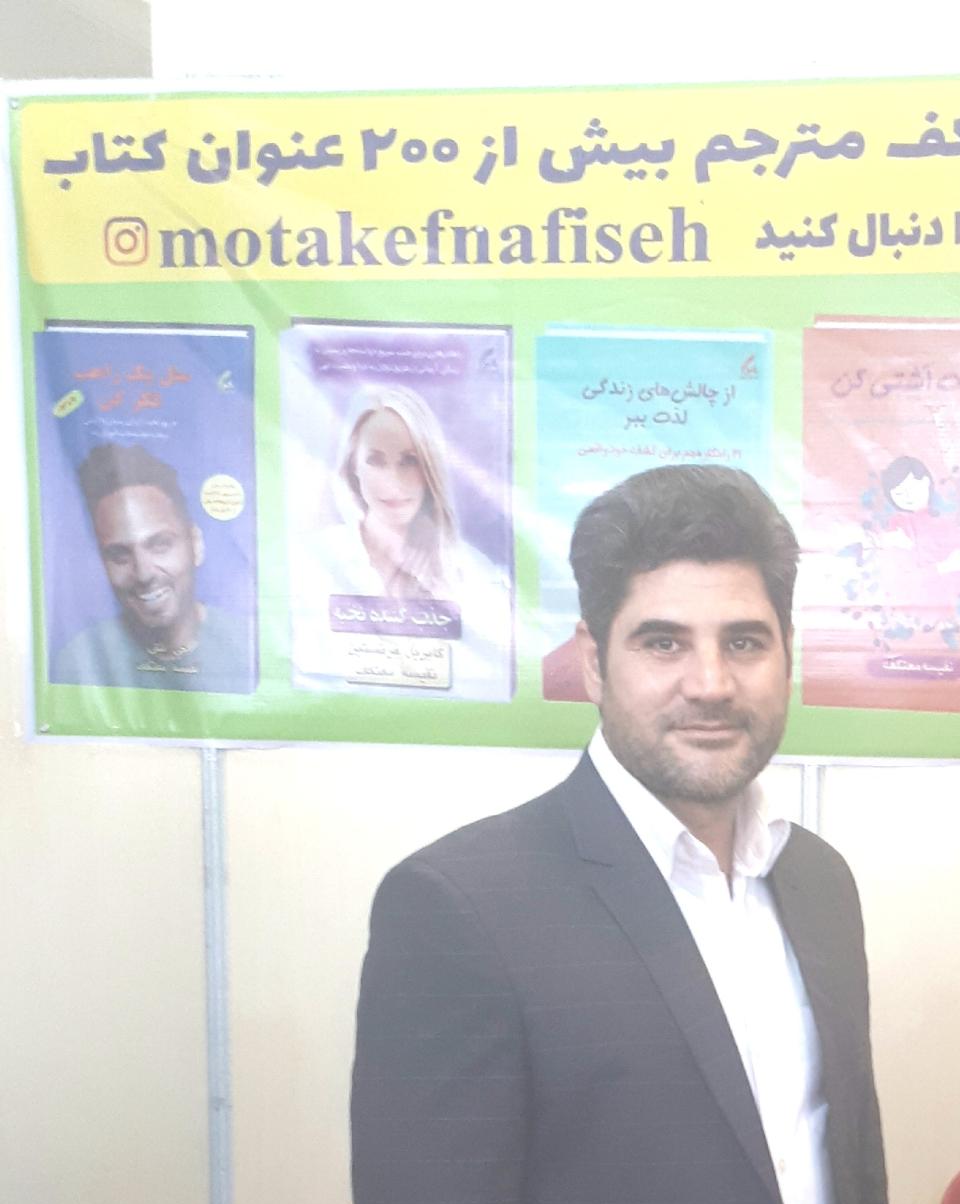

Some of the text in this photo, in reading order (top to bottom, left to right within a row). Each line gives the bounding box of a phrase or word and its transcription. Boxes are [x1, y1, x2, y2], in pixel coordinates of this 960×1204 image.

[43, 127, 168, 189] کتاب
[187, 127, 345, 187] عنوان
[363, 127, 460, 172] ۲۰۰
[473, 125, 519, 185] از
[538, 118, 676, 184] بیش
[695, 122, 865, 183] مترجم
[160, 206, 712, 269] motakefnafiseh
[756, 213, 838, 262] کنید
[847, 214, 943, 260] دنبال
[580, 376, 635, 402] زندگی
[722, 383, 738, 407] از
[830, 366, 868, 400] کن
[869, 361, 934, 400] آشتی
[623, 406, 690, 431] لذت ببر
